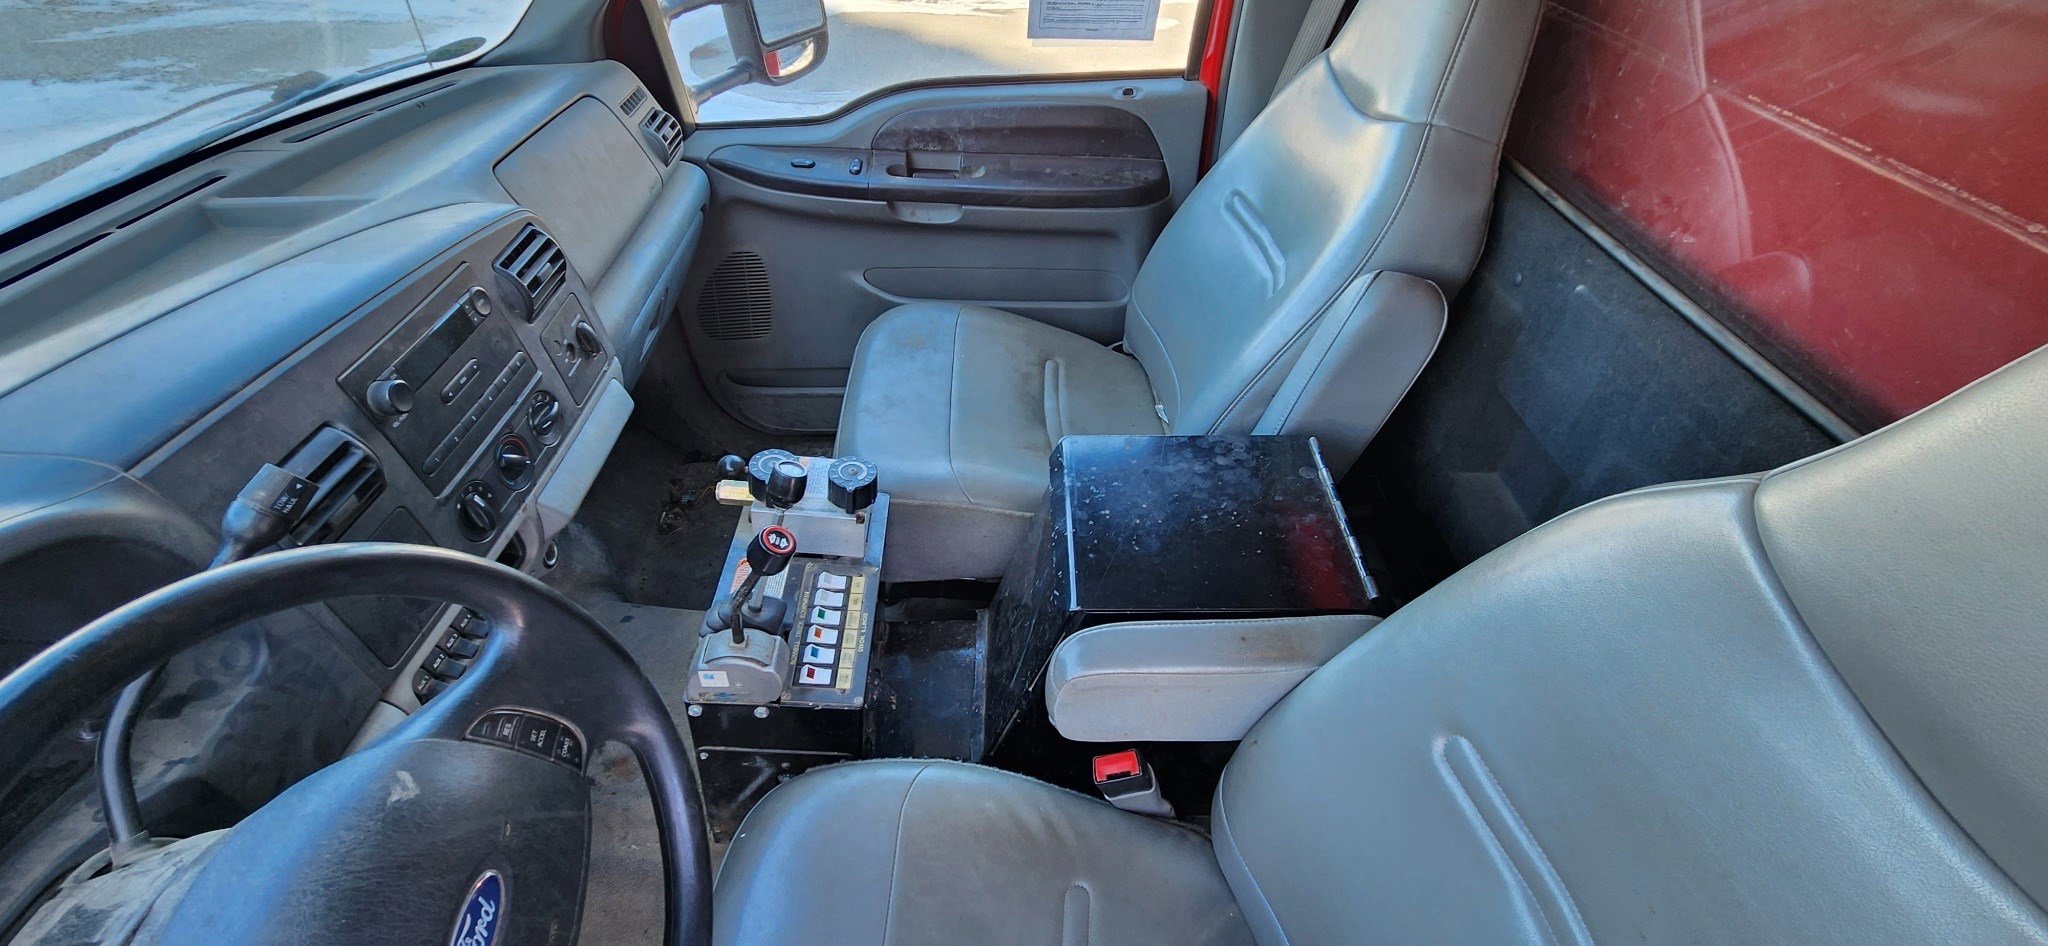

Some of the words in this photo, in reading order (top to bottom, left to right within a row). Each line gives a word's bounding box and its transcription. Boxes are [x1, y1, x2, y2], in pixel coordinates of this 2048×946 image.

[446, 638, 455, 648] AUX
[433, 658, 441, 669] AUX
[502, 722, 512, 736] RES
[537, 729, 547, 748] ACCEL
[561, 737, 571, 758] COAST
